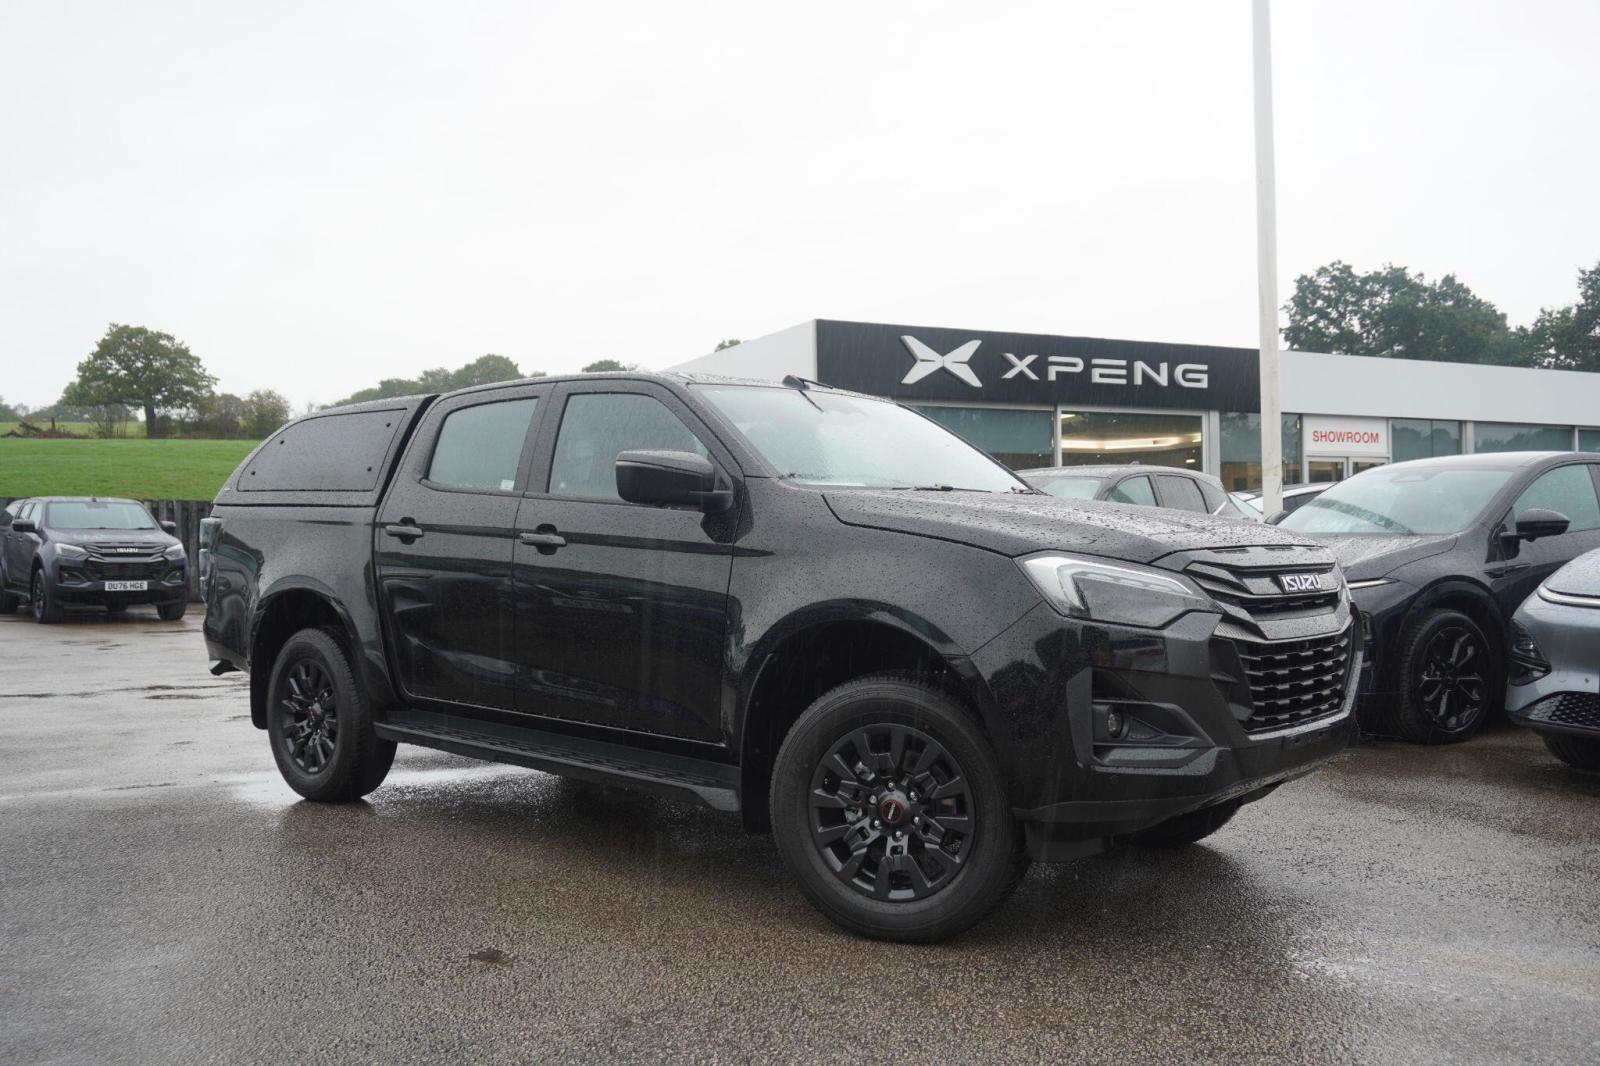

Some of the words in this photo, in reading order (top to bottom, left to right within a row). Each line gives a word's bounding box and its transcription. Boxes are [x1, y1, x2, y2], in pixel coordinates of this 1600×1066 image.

[1001, 352, 1209, 389] XPENG
[1312, 430, 1380, 444] SHOWROOM
[1281, 574, 1322, 592] ISUZU
